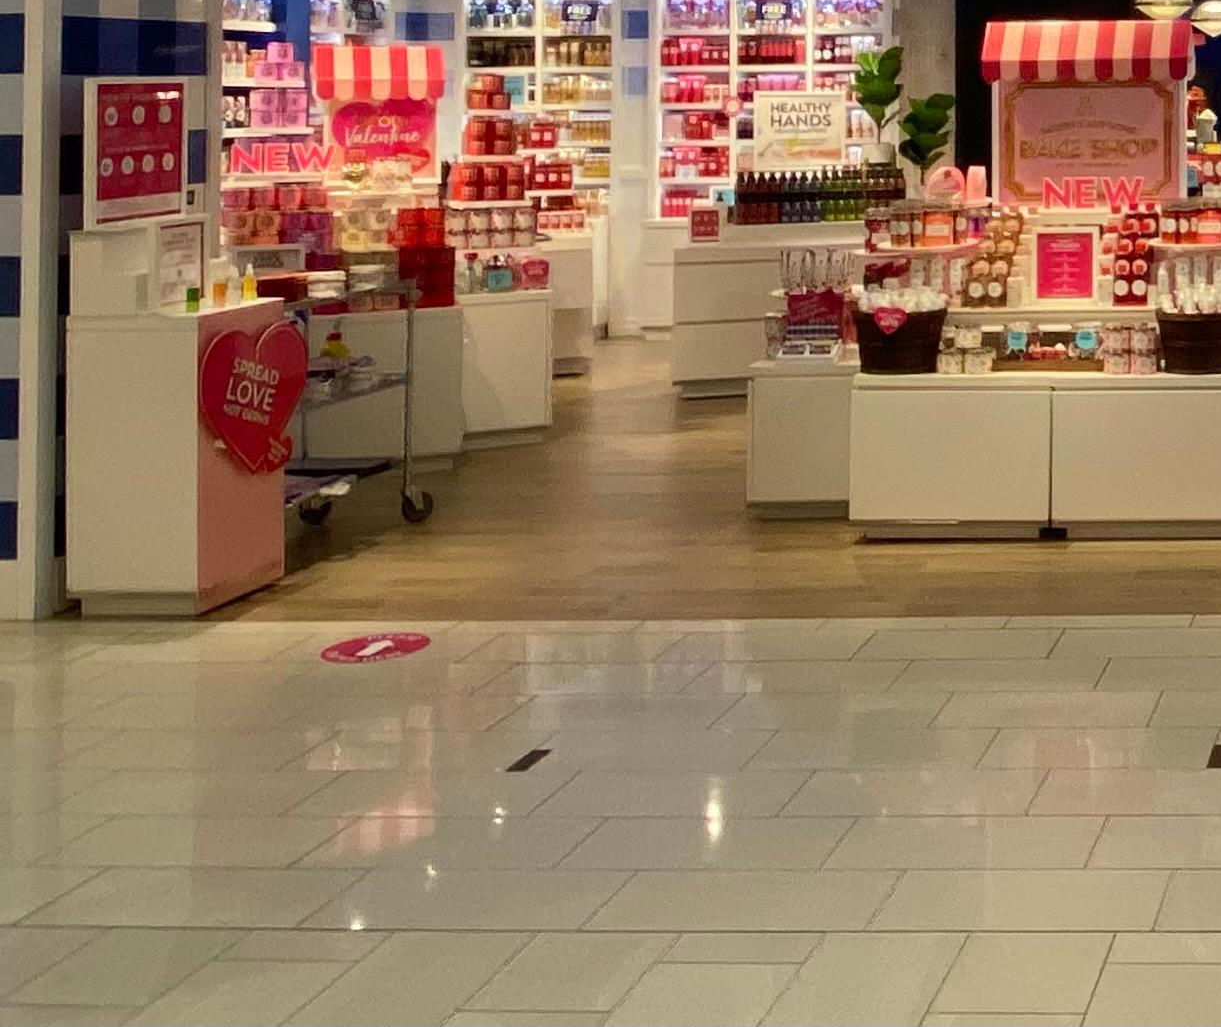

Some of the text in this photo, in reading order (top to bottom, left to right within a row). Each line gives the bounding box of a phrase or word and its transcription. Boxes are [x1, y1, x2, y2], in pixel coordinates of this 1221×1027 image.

[770, 101, 832, 113] HEALTHY
[770, 114, 832, 127] HANDS
[344, 124, 421, 148] Valentine
[231, 140, 337, 174] NEW
[1042, 175, 1145, 210] NEW
[233, 356, 280, 386] SPREAD
[226, 376, 277, 412] LOVE
